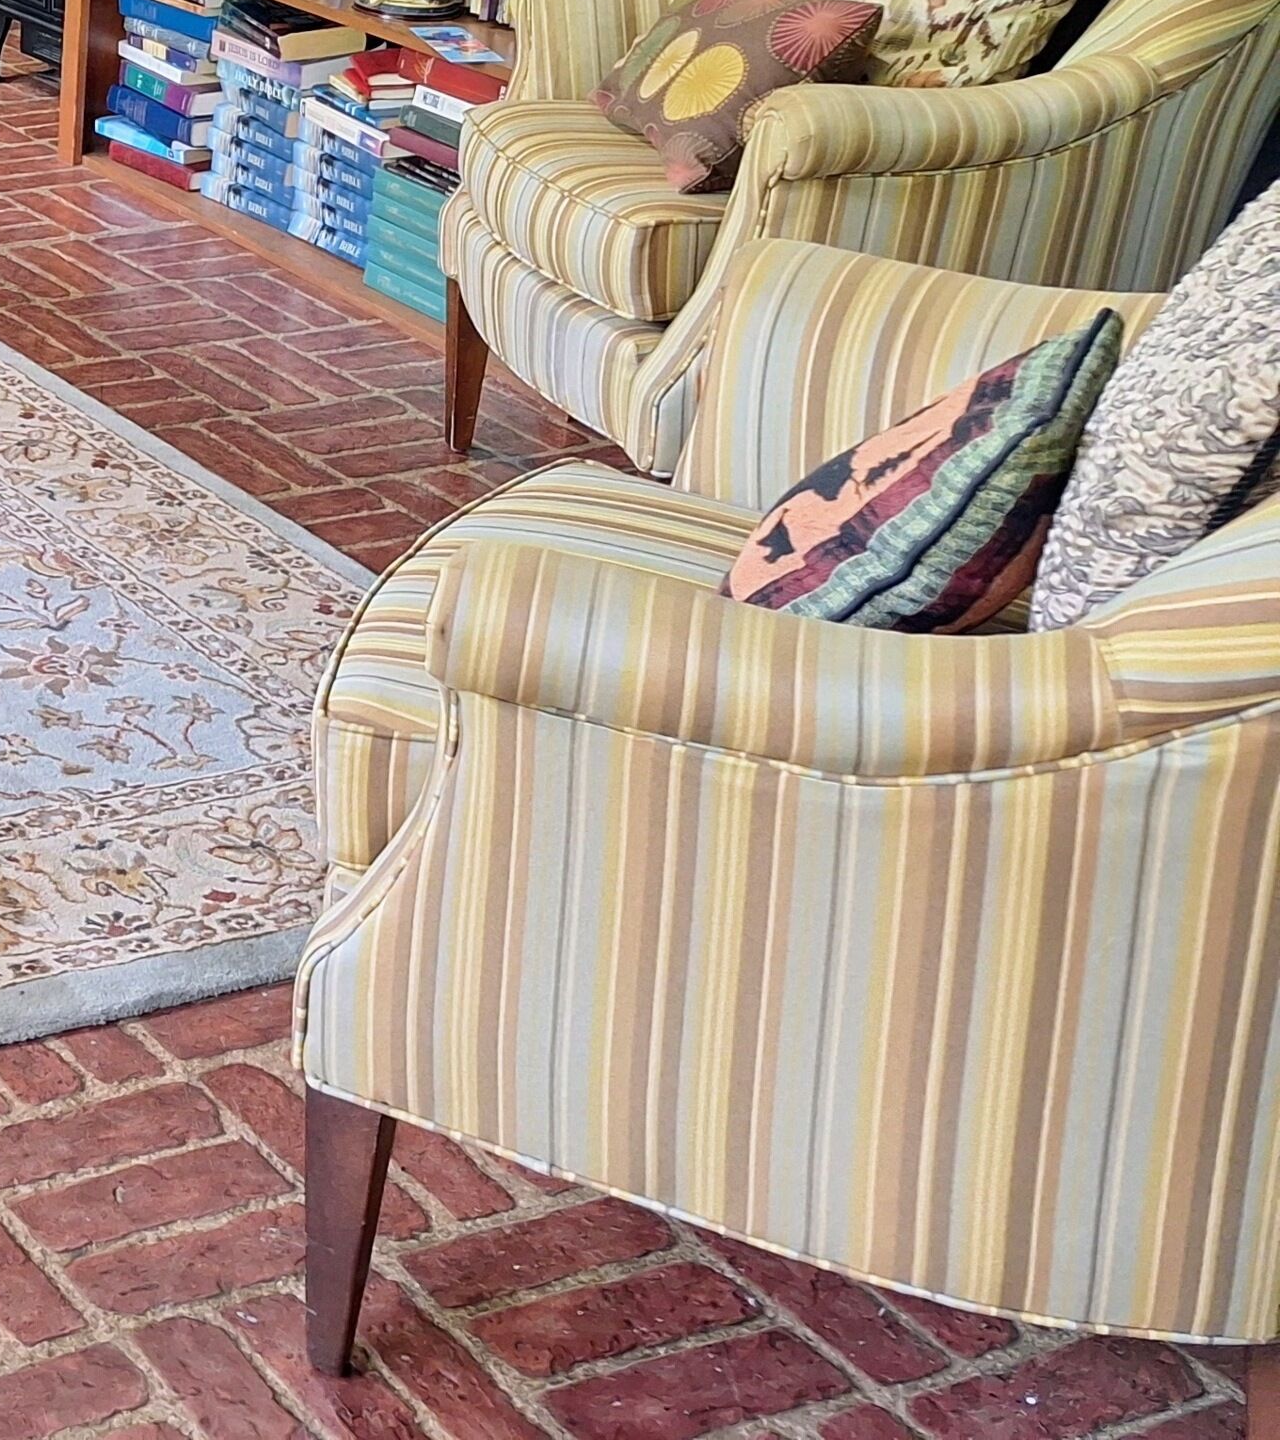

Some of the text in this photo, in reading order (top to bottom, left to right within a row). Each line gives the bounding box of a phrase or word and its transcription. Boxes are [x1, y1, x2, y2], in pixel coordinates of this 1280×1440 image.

[228, 42, 280, 69] JESUS IS LORD
[234, 69, 282, 100] HOLY BIBLE
[255, 131, 272, 148] BIBLE
[247, 152, 265, 169] BIBLE
[341, 145, 358, 163] BIBLE
[254, 176, 272, 193] BIBLE
[341, 171, 360, 189] BIBLE
[248, 200, 267, 218] BIBLE
[336, 194, 354, 212] BIBLE
[343, 218, 362, 236] BIBLE
[340, 239, 360, 258] BIBLE
